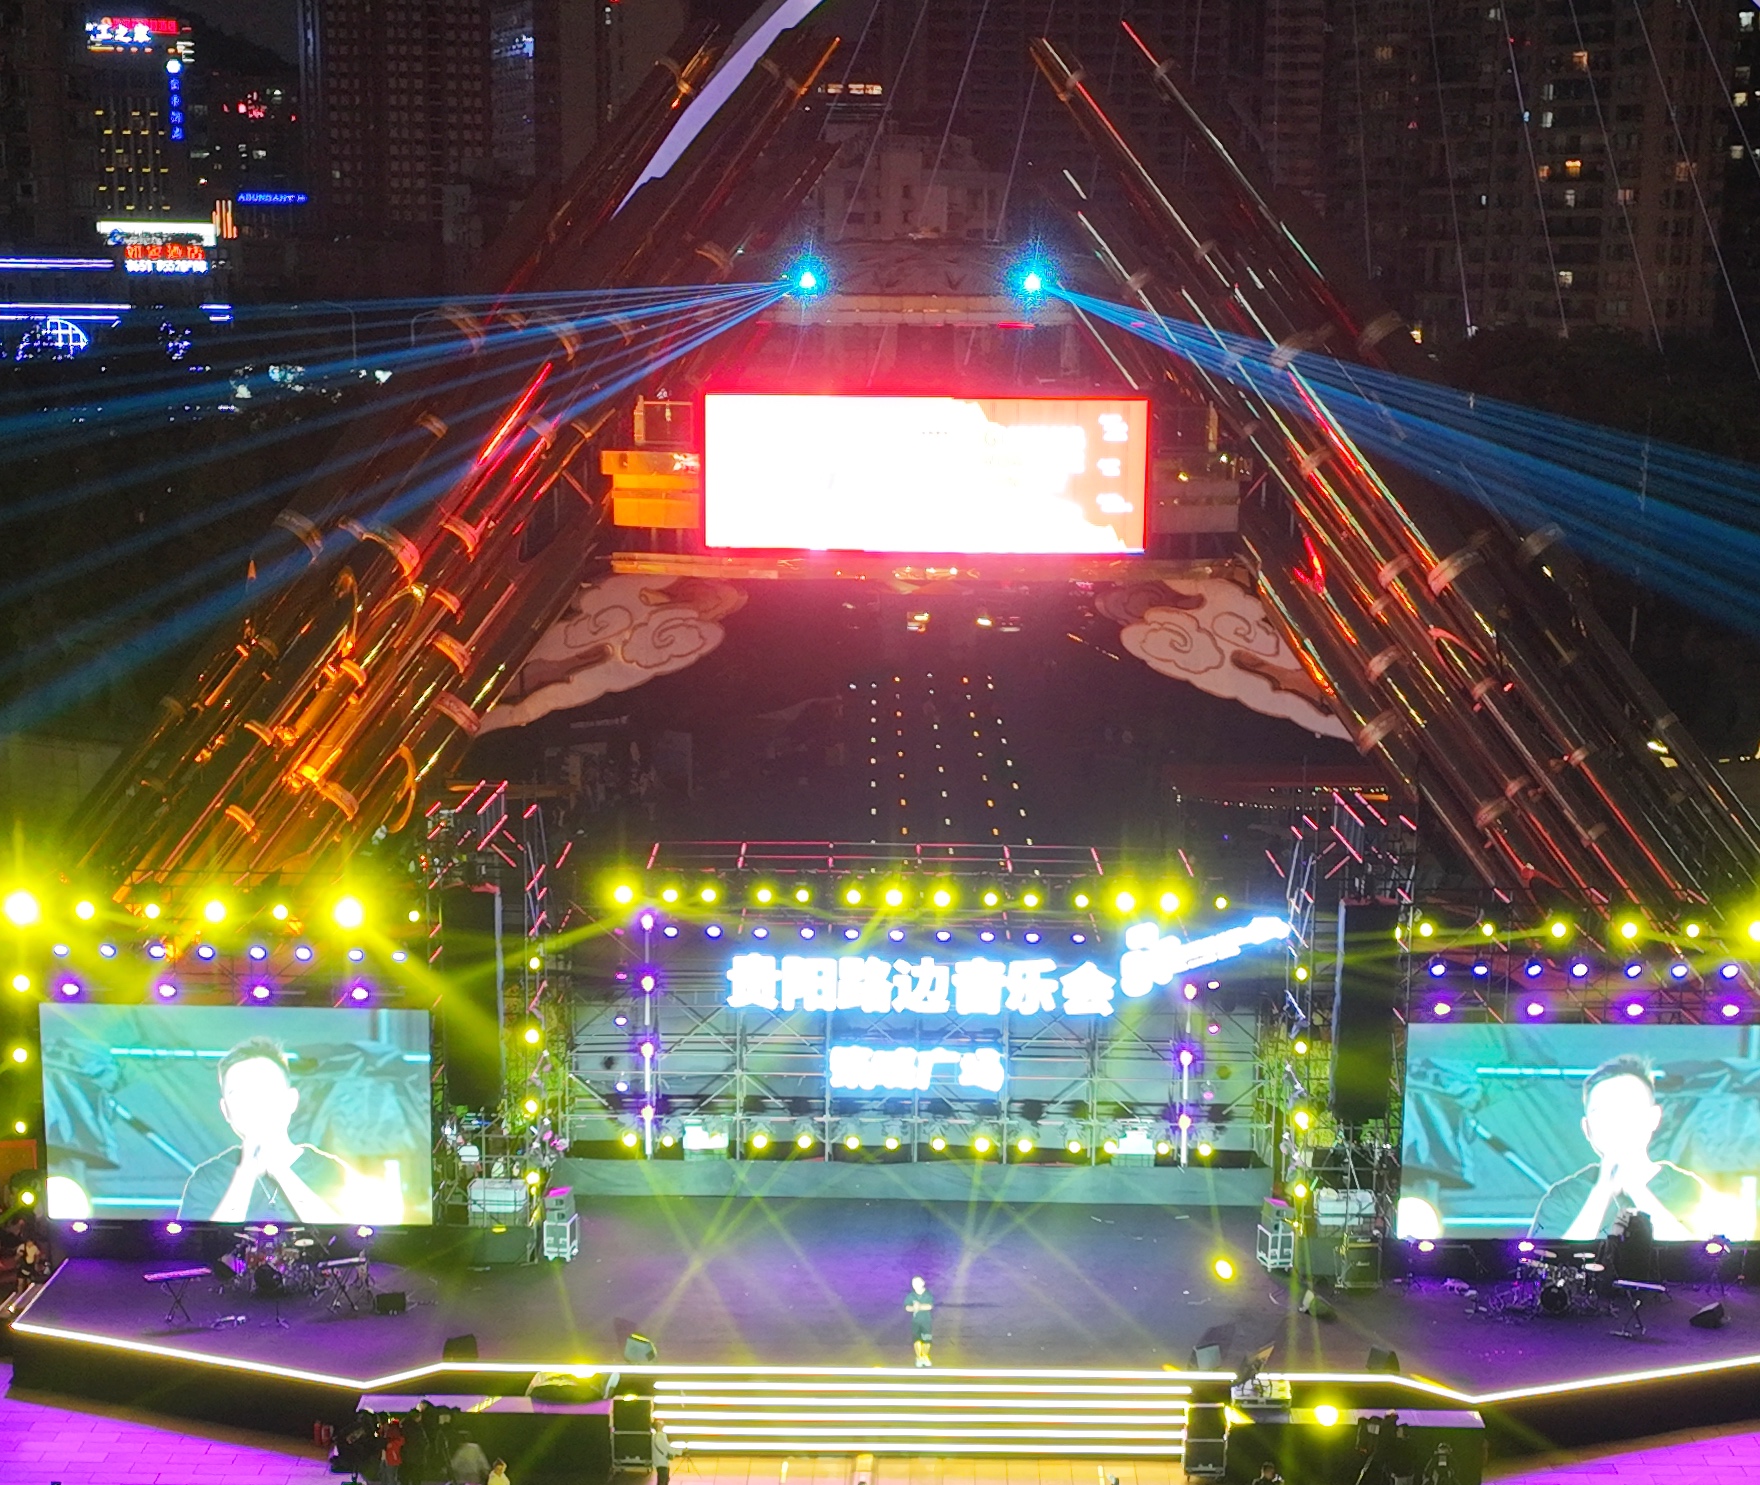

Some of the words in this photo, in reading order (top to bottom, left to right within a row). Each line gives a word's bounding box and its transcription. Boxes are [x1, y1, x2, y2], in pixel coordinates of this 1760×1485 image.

[727, 953, 1117, 1017] 贵阳路边音乐会
